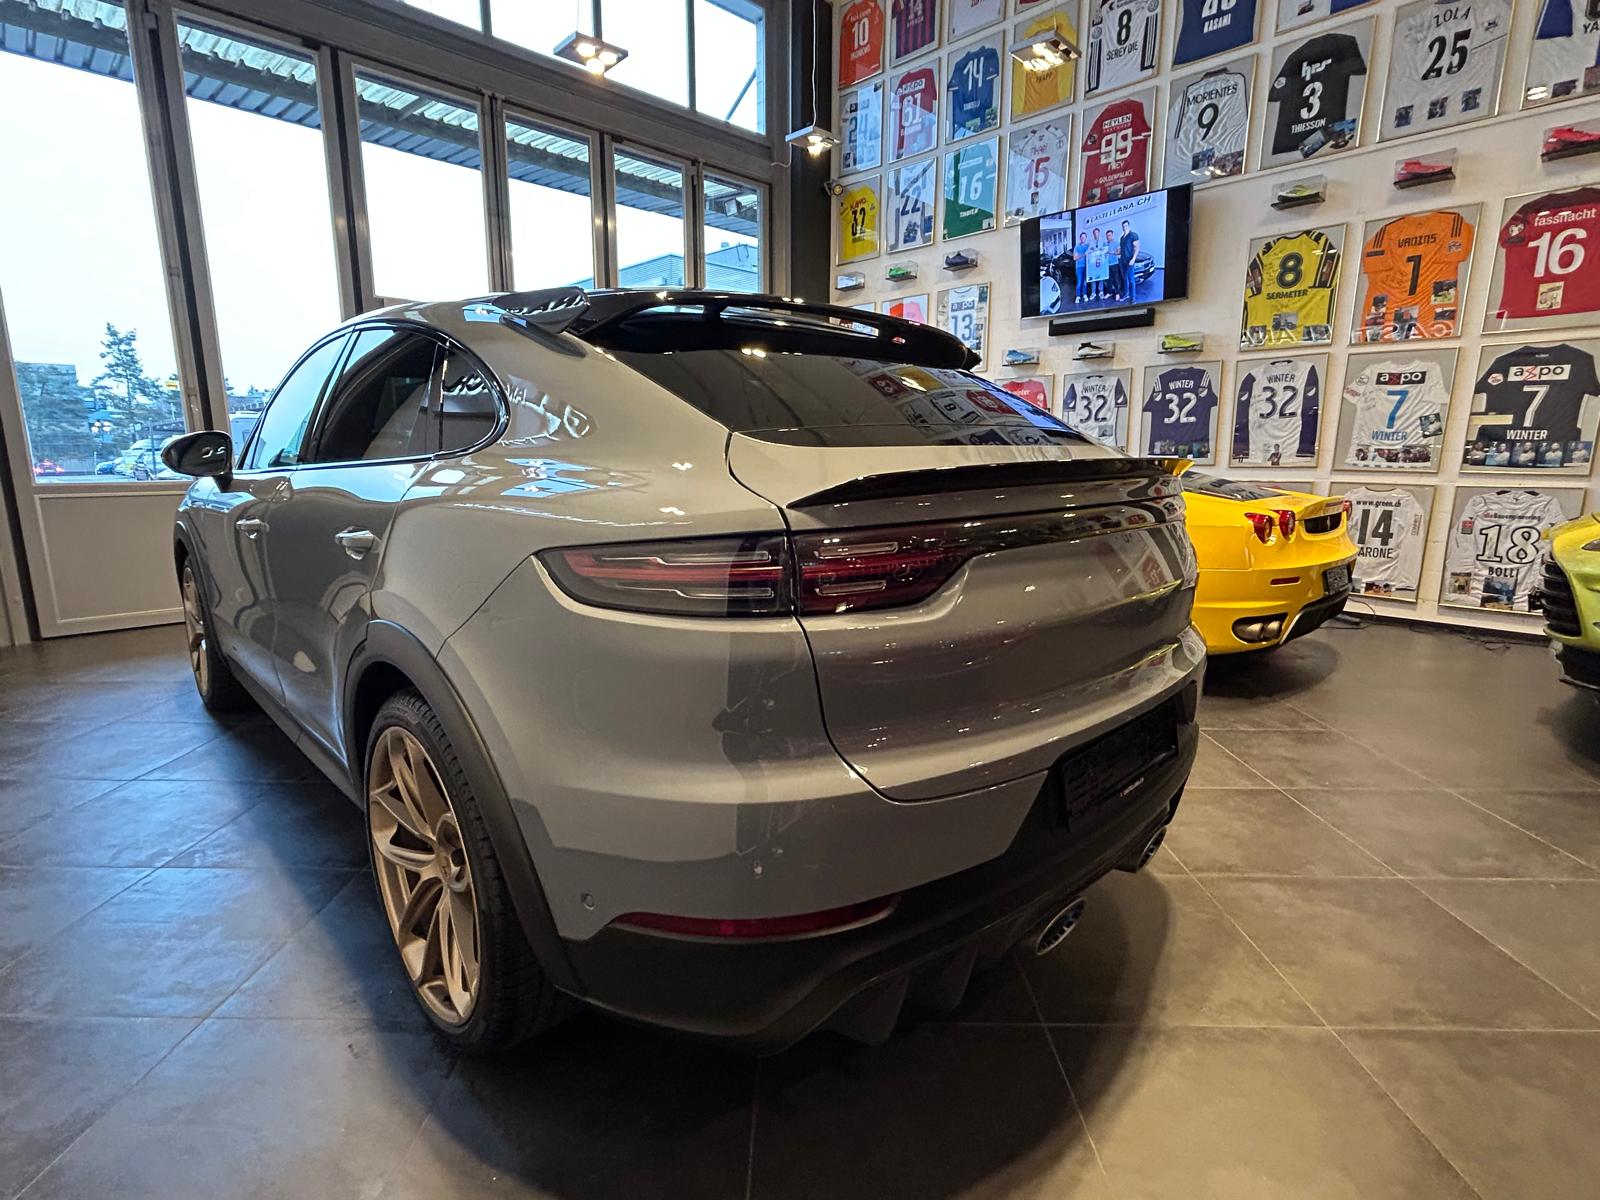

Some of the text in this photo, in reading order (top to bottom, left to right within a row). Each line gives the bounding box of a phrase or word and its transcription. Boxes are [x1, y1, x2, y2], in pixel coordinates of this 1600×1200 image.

[1117, 9, 1132, 46] 8
[1433, 6, 1472, 28] ZOLA
[852, 17, 870, 50] 10
[1301, 58, 1333, 81] hrs
[1421, 28, 1472, 81] 25
[963, 56, 985, 92] 14
[1187, 83, 1238, 107] MORIENTES
[1300, 81, 1323, 120] 3
[1103, 115, 1131, 129] HEYLEN
[1197, 103, 1219, 141] 9
[1291, 117, 1327, 134] THIESSON
[1100, 128, 1132, 165] 99
[1024, 156, 1050, 190] 15
[1107, 160, 1125, 171] FREY
[901, 186, 921, 216] 22
[959, 171, 984, 204] 16
[1534, 207, 1597, 227] fassnacht
[1528, 228, 1588, 278] 16
[1276, 252, 1304, 289] 8
[1406, 255, 1422, 296] 1
[1266, 289, 1309, 300] SERMETER
[951, 314, 973, 341] 13
[1083, 384, 1108, 394] WINTER
[1168, 379, 1195, 391] WINTER
[1266, 373, 1296, 384] WINTER
[1080, 394, 1108, 423] 32
[1163, 392, 1197, 424] 32
[1260, 385, 1298, 419] 32
[1386, 390, 1409, 429] 7
[1523, 384, 1549, 427] 7
[1371, 430, 1408, 440] WINTER
[1506, 429, 1548, 440] WINTER
[1357, 509, 1394, 546] 14
[1358, 546, 1393, 559] ARONE
[1476, 524, 1541, 565] 18
[1488, 567, 1519, 578] BOLLI
